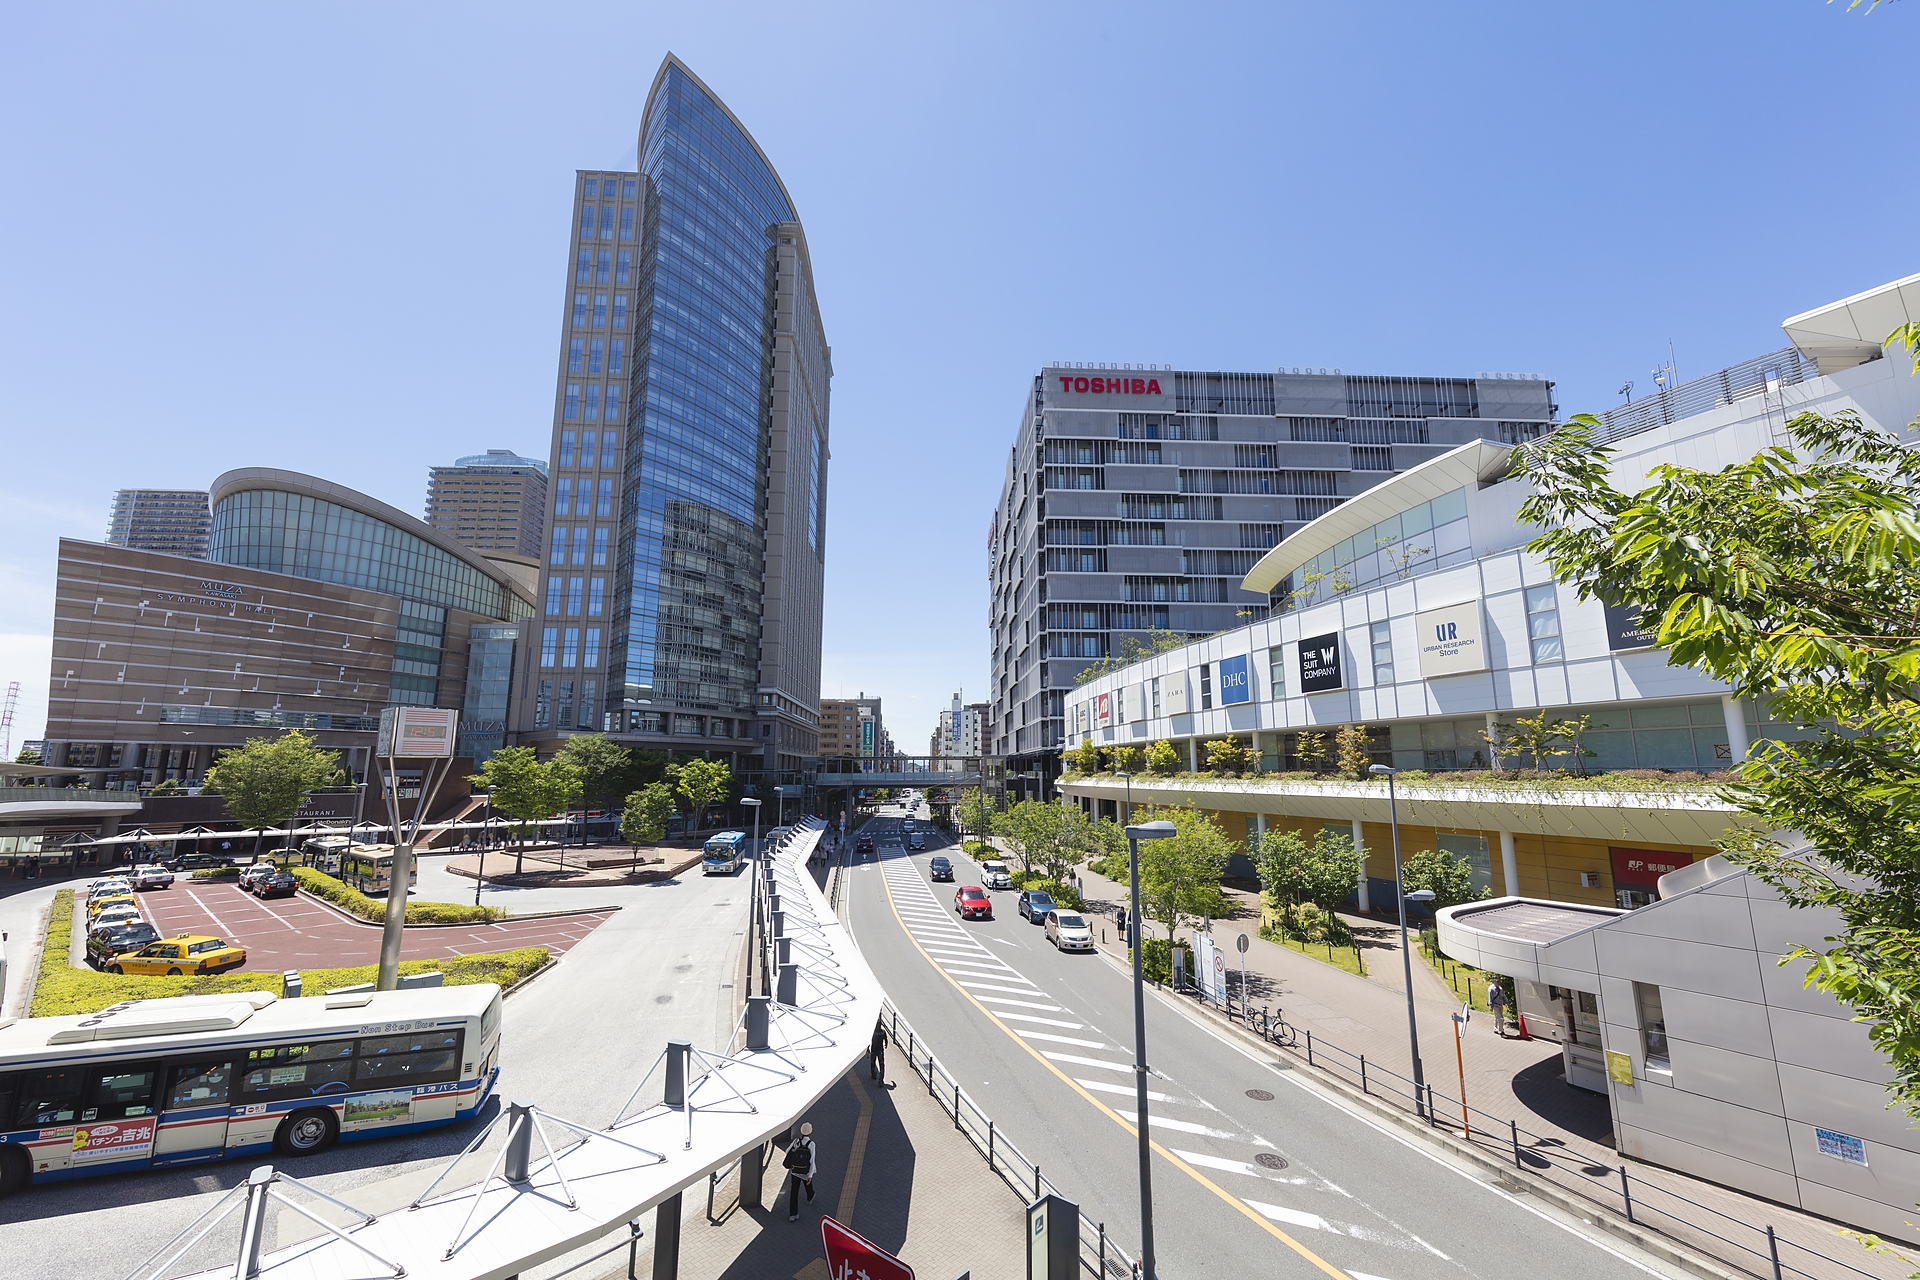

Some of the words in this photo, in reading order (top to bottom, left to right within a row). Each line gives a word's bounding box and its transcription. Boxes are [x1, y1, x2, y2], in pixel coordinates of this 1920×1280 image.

[1059, 376, 1162, 395] TOSHIBA
[200, 581, 243, 595] MUZA
[205, 590, 237, 599] KAWASAKI
[157, 593, 236, 609] SYMPHONY
[245, 605, 275, 615] HALL
[1435, 622, 1458, 642] UR
[1621, 628, 1654, 638] AMERIC
[1423, 644, 1442, 652] URBAN
[1443, 639, 1475, 649] RESEARCH
[1302, 650, 1316, 660] THE
[1439, 649, 1458, 657] Store
[1303, 659, 1318, 670] SUIT
[1303, 666, 1337, 680] COMPANY
[1222, 671, 1246, 688] DHC
[1167, 689, 1184, 697] ZARA
[409, 726, 446, 737] 12:51
[457, 721, 506, 732] MUZA
[361, 1025, 381, 1035] Non
[384, 1022, 412, 1033] Step
[414, 1020, 435, 1030] Bus
[416, 1083, 459, 1094] 臨港バス
